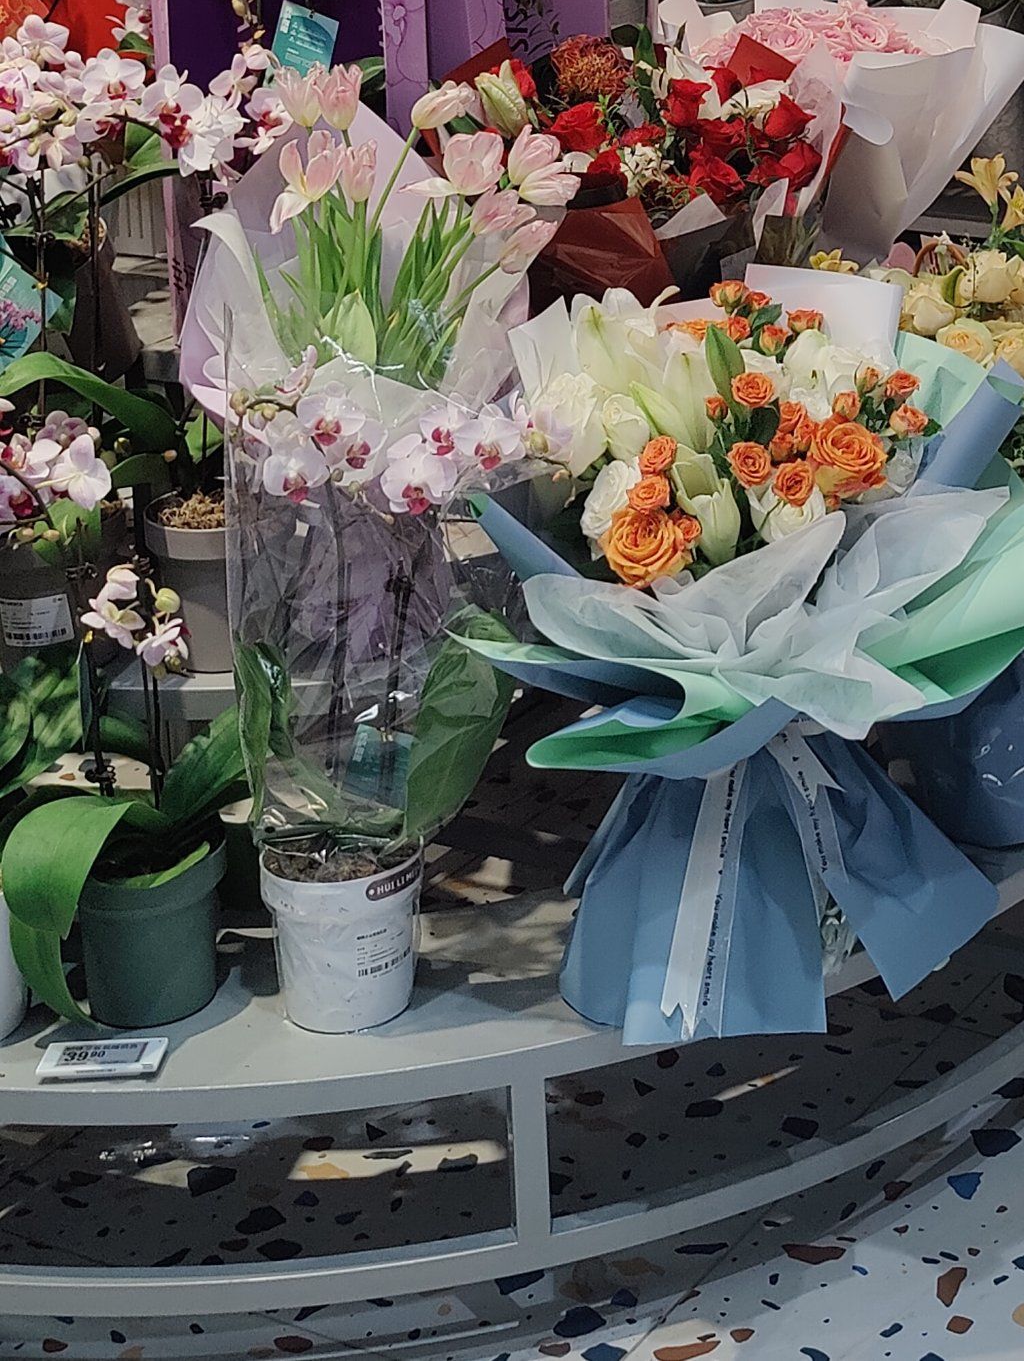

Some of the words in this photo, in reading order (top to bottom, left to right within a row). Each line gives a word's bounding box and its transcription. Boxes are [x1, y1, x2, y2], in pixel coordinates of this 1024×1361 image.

[726, 779, 736, 798] make
[723, 798, 733, 812] my
[722, 812, 734, 835] heart
[718, 835, 729, 859] smile
[814, 831, 825, 855] make
[820, 855, 829, 874] You
[714, 893, 724, 911] You
[710, 912, 721, 937] make
[707, 938, 718, 954] my
[704, 954, 716, 981] heart
[702, 982, 713, 1007] smile
